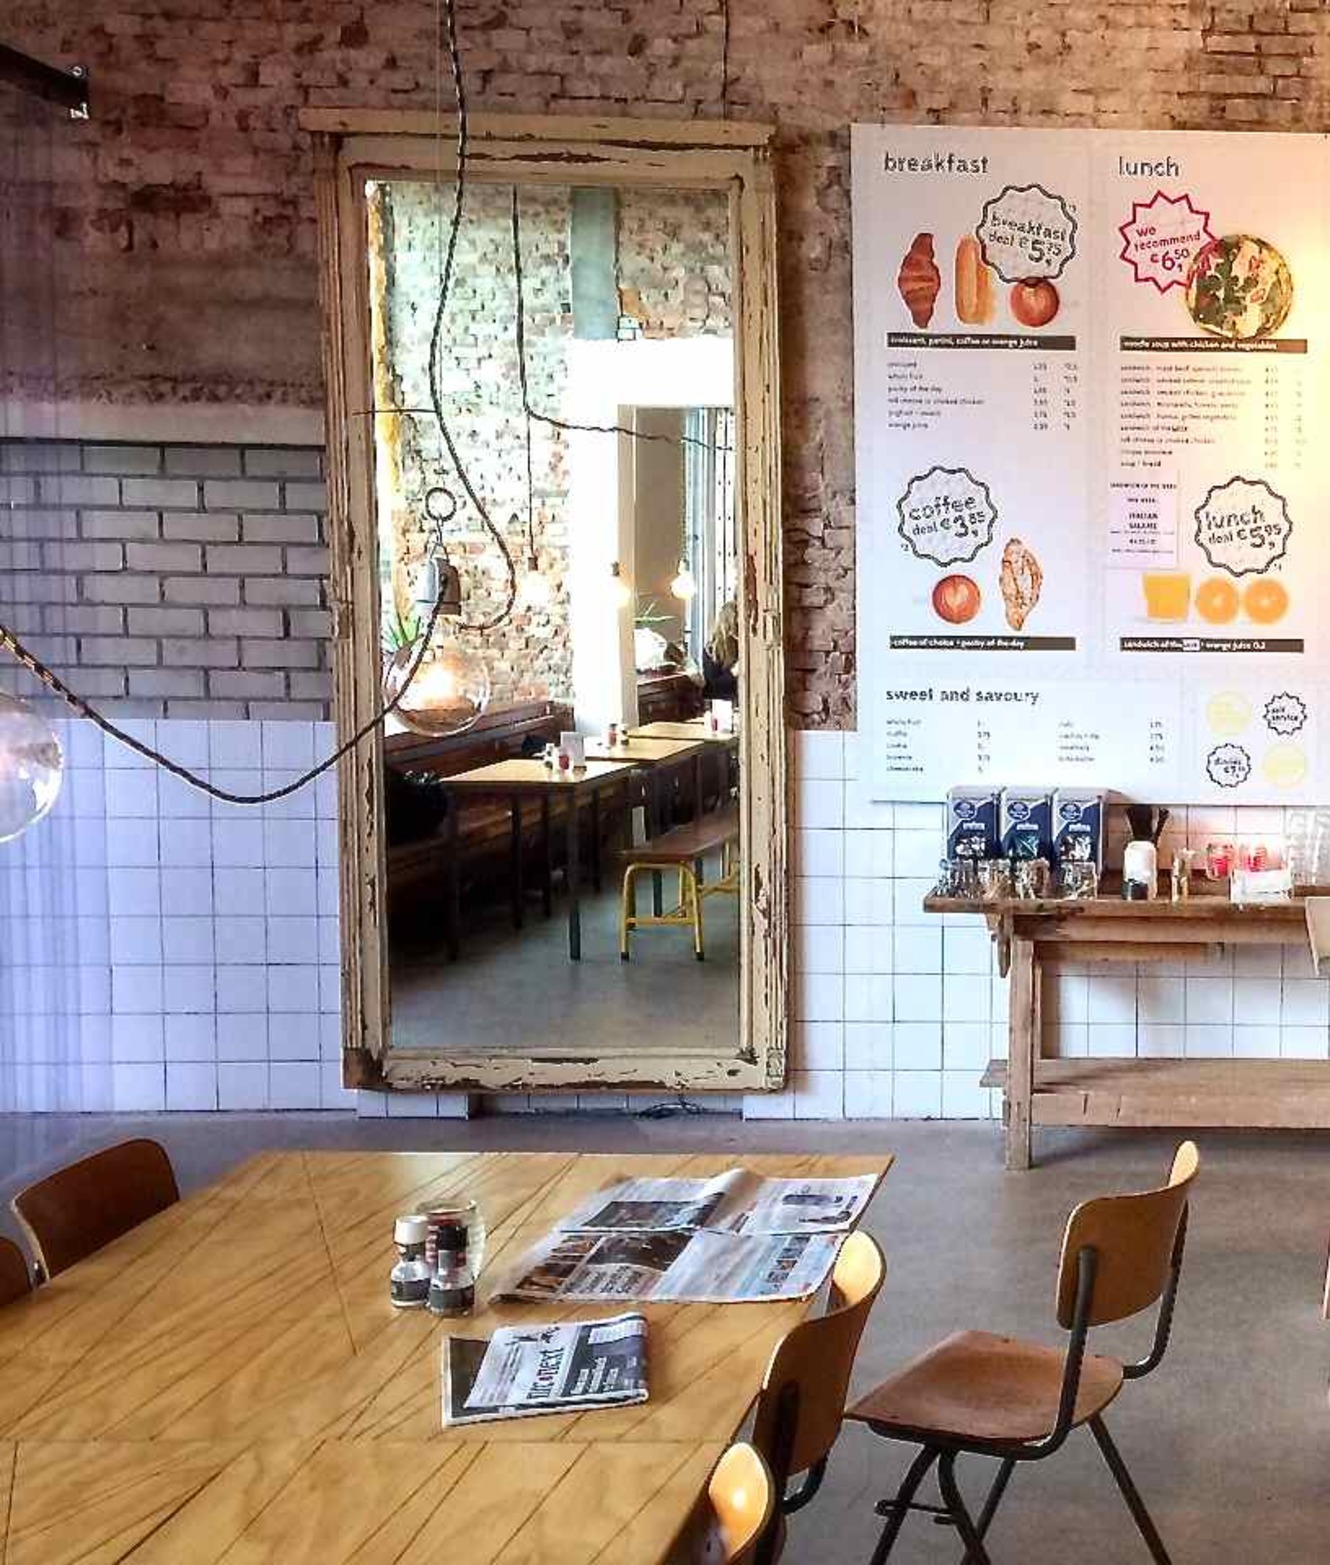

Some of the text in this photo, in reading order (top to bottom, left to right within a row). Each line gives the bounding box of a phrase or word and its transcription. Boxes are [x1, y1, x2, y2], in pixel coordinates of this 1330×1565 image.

[884, 152, 989, 174] breakfast
[1119, 156, 1180, 177] lunch
[991, 212, 1066, 241] breakfast
[988, 231, 1014, 246] deal
[1134, 230, 1200, 251] recommend
[909, 495, 977, 521] coffee
[1205, 505, 1265, 531] lunch
[912, 521, 938, 536] deal
[1209, 532, 1234, 544] deal
[886, 687, 1040, 706] sweet and savoury
